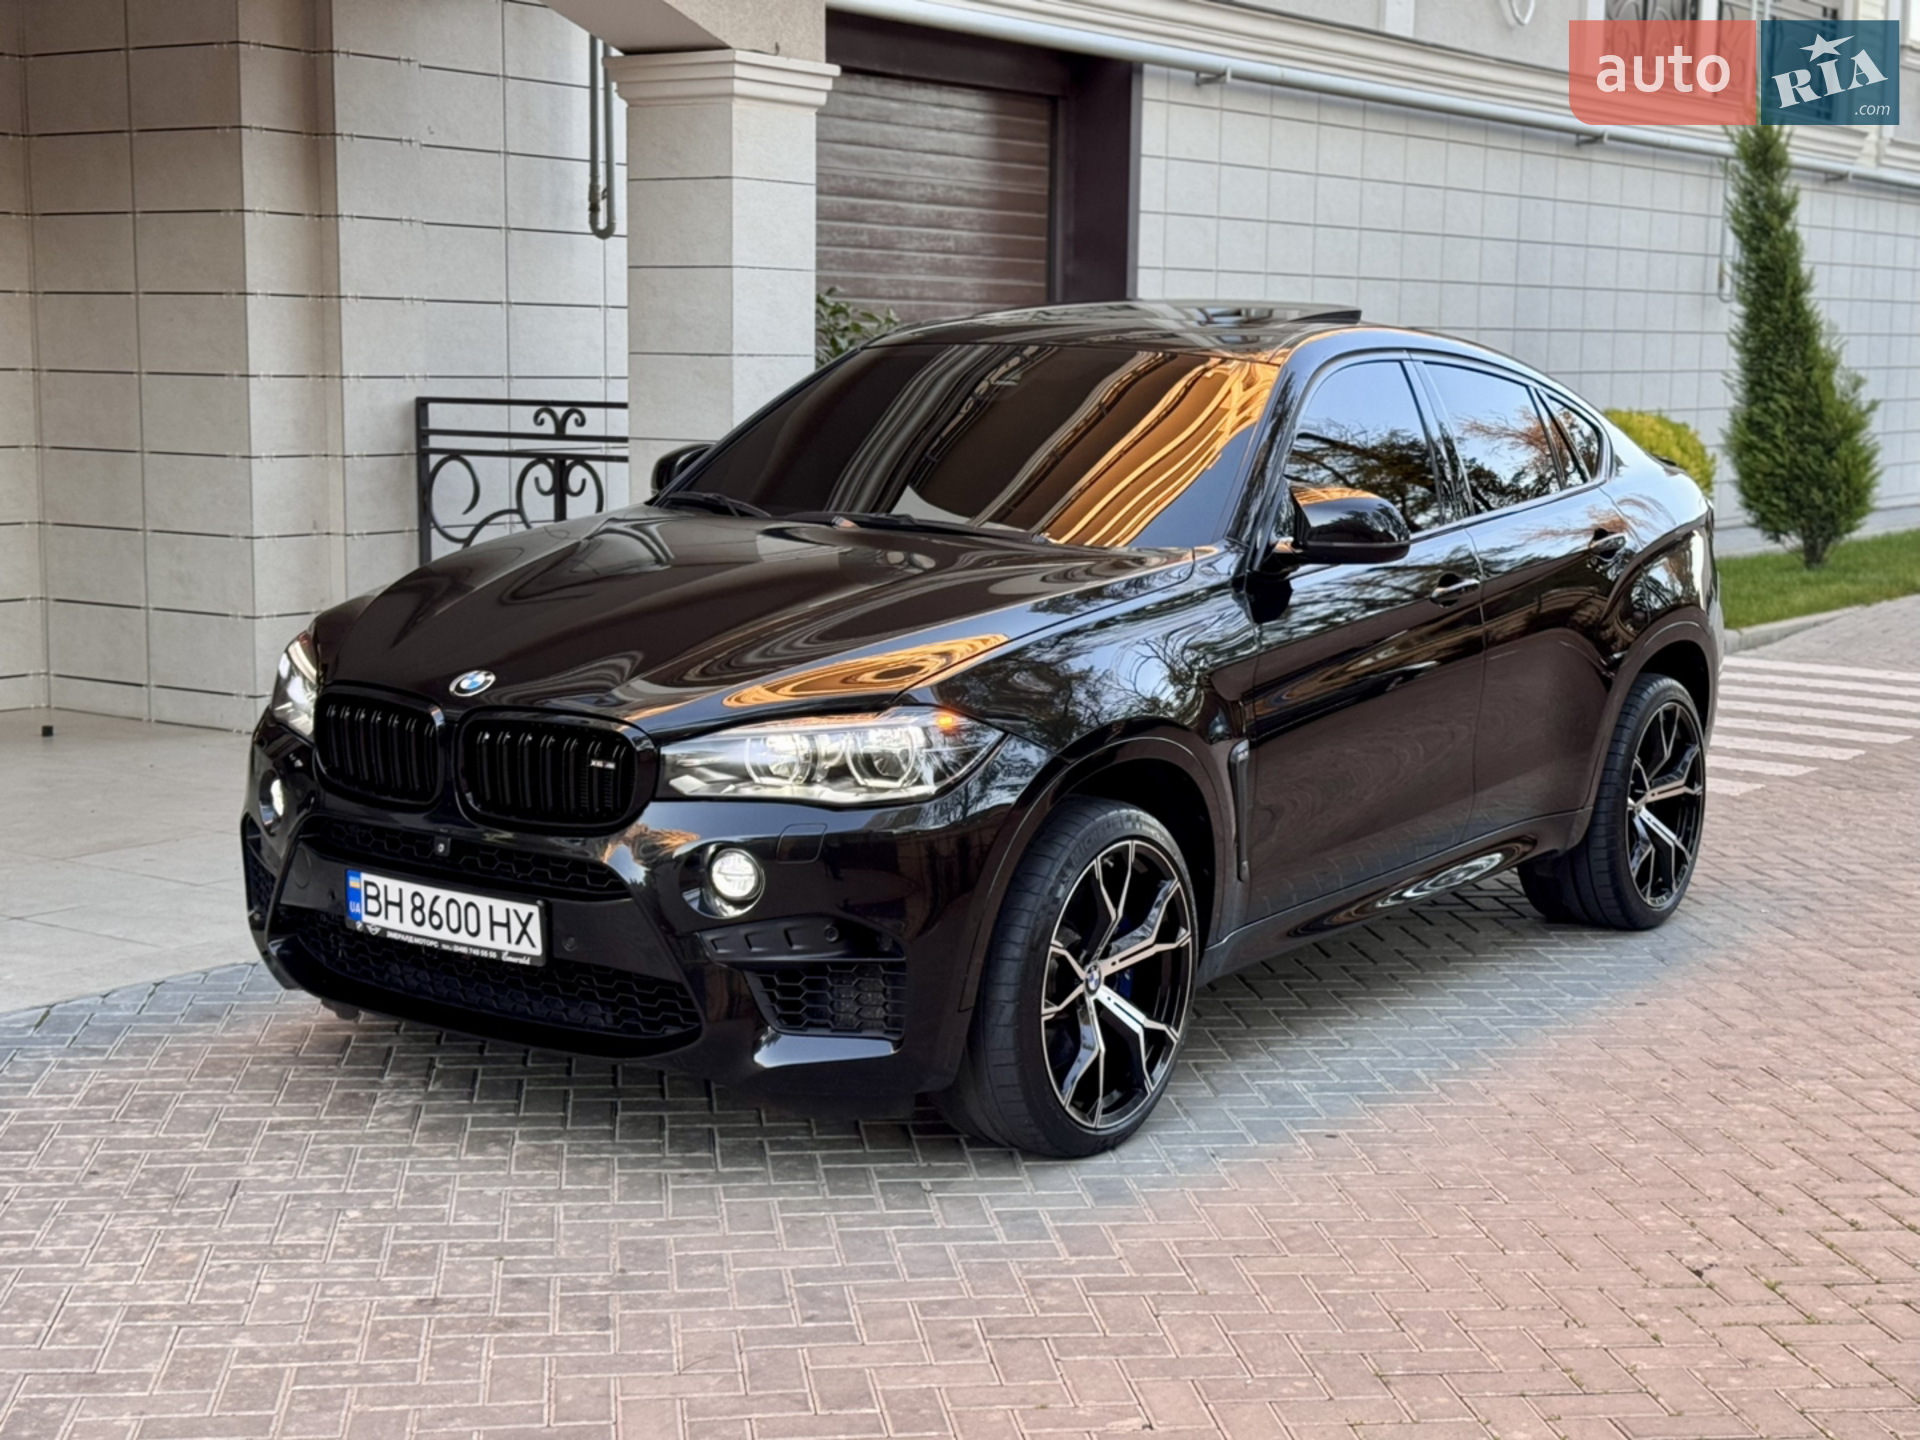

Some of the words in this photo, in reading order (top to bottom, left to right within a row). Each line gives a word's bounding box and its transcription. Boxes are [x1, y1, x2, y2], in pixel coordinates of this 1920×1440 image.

[350, 901, 361, 914] UA
[363, 879, 404, 924] BH
[410, 891, 481, 938] 8600
[488, 904, 537, 949] HX
